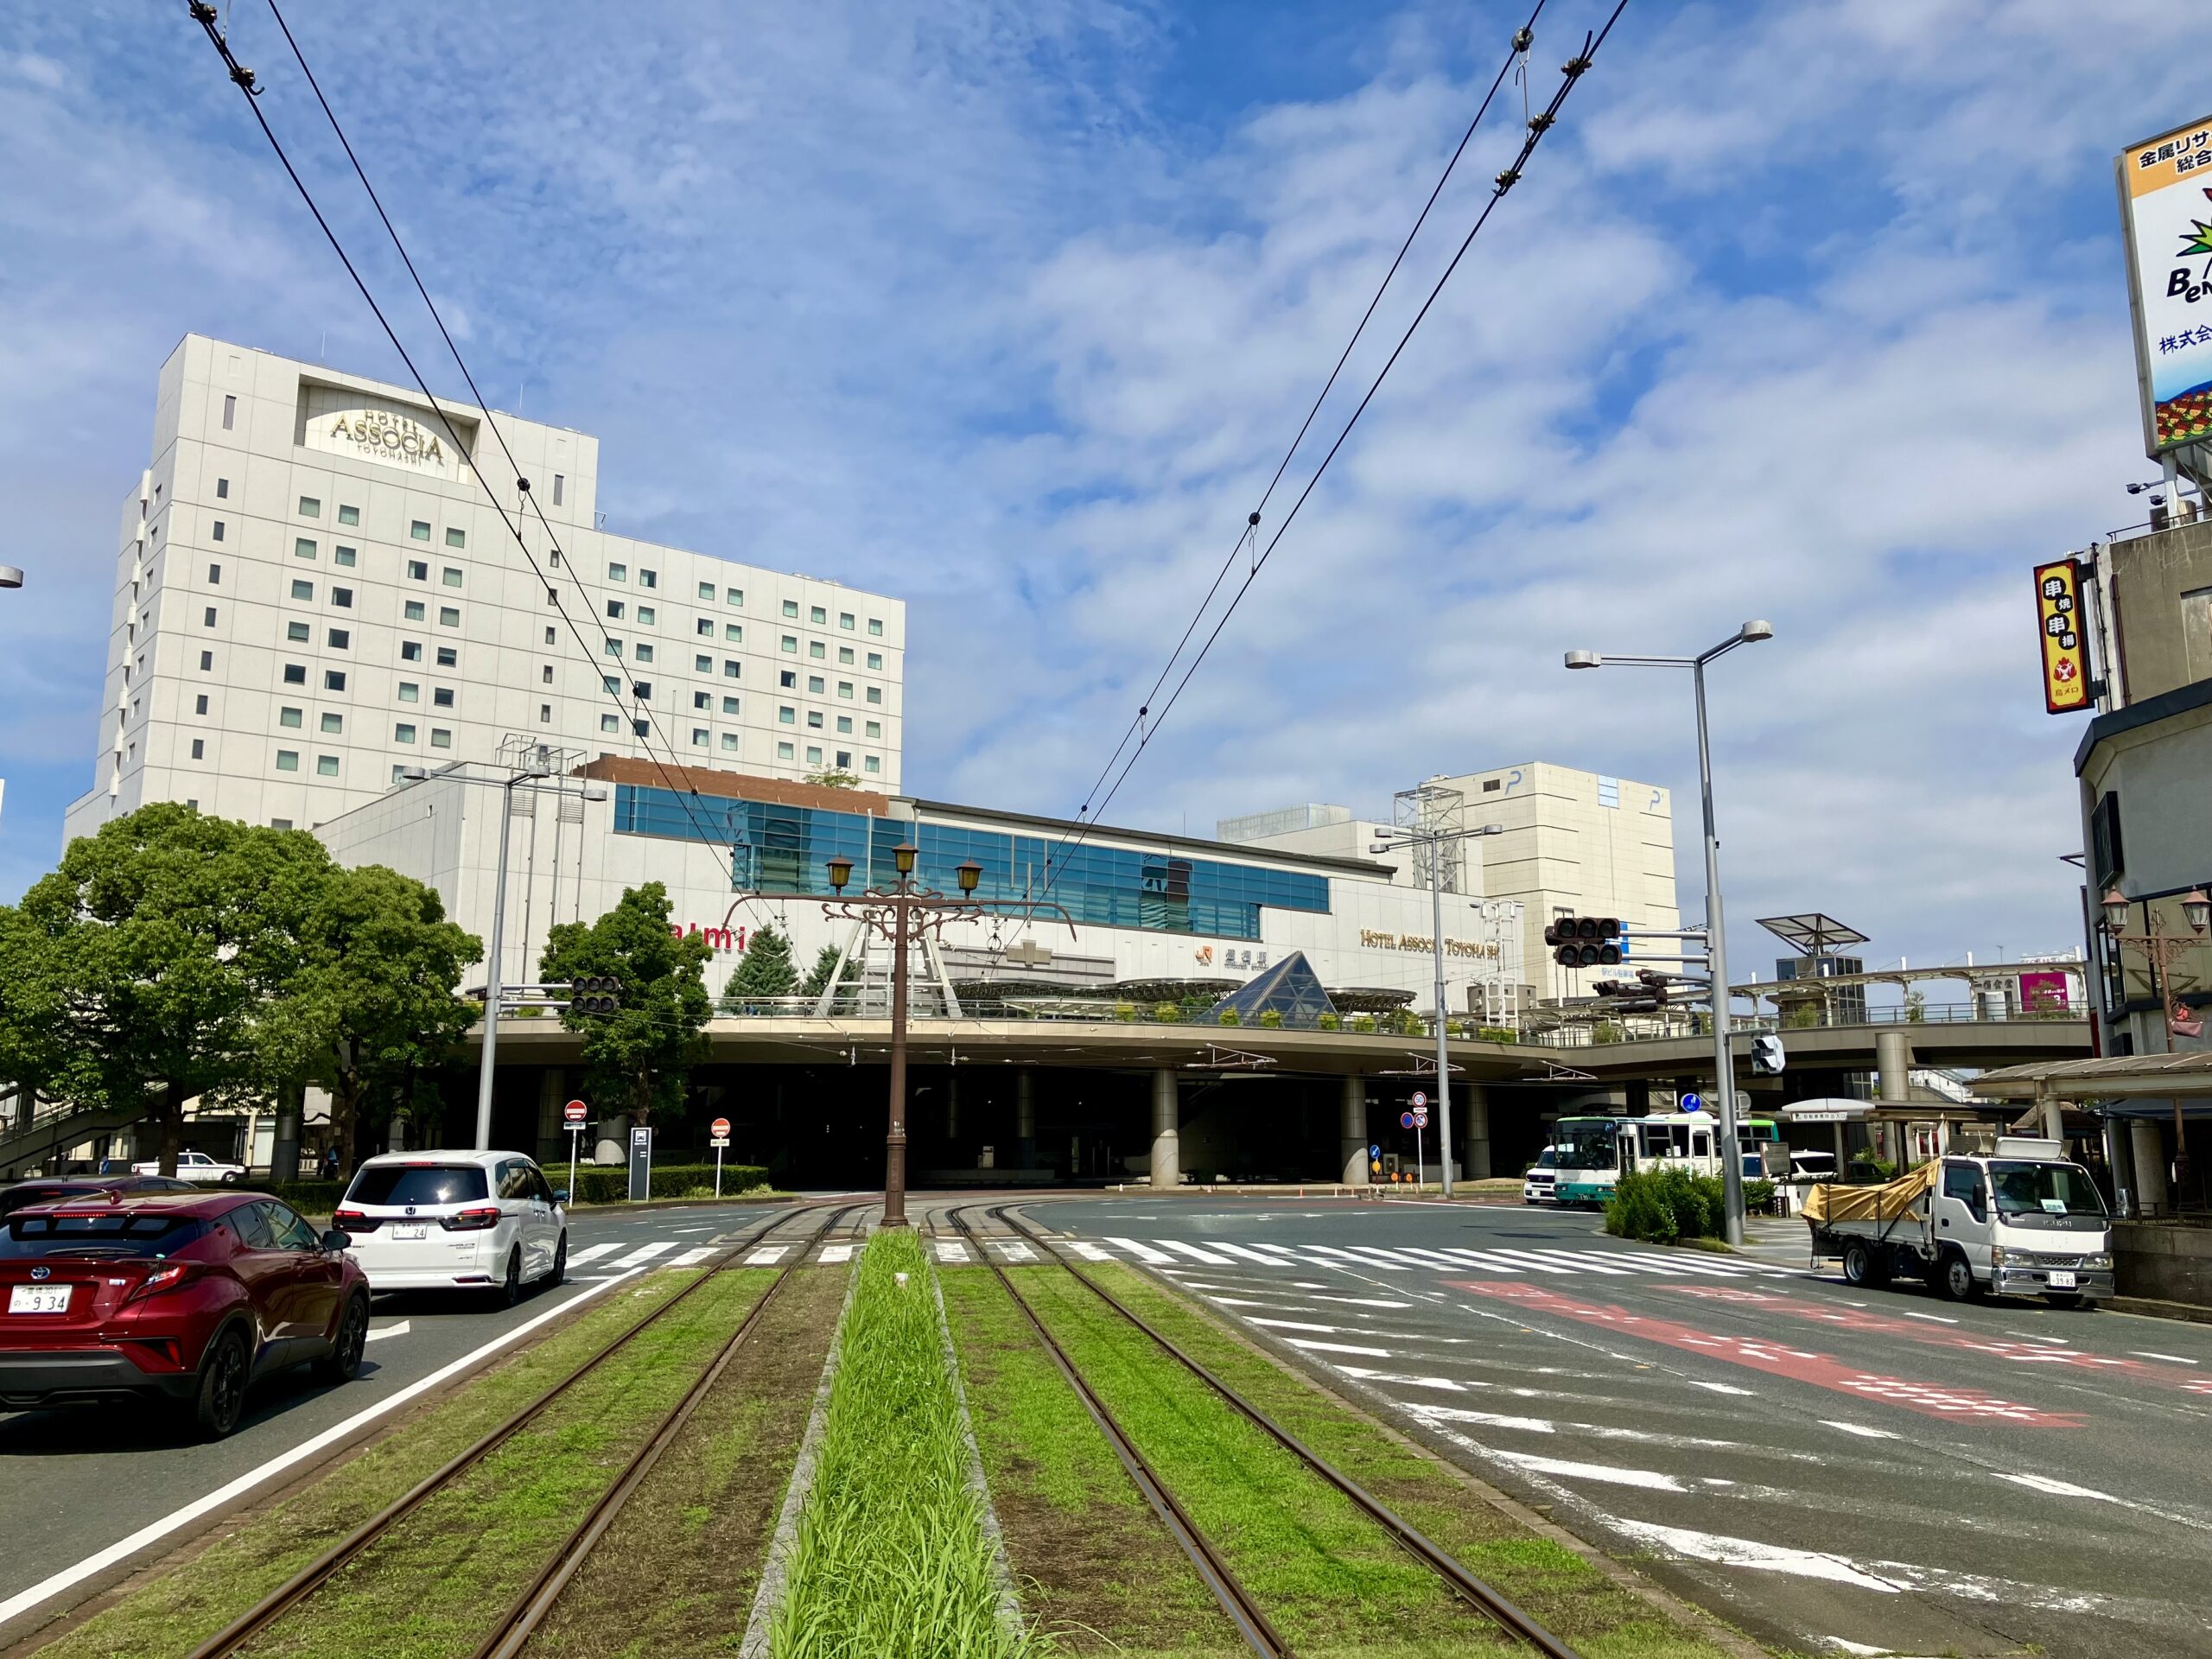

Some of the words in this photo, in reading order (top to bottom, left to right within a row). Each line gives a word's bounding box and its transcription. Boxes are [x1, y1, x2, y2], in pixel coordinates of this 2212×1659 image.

[2139, 130, 2209, 168] 金属リサ
[2177, 149, 2212, 173] 総合
[2159, 324, 2212, 355] 株式会
[330, 414, 445, 466] ASSOCIA
[357, 443, 422, 467] TOYOHASHI
[1360, 929, 1396, 950] HOTEL
[1398, 933, 1442, 955] ASSOC
